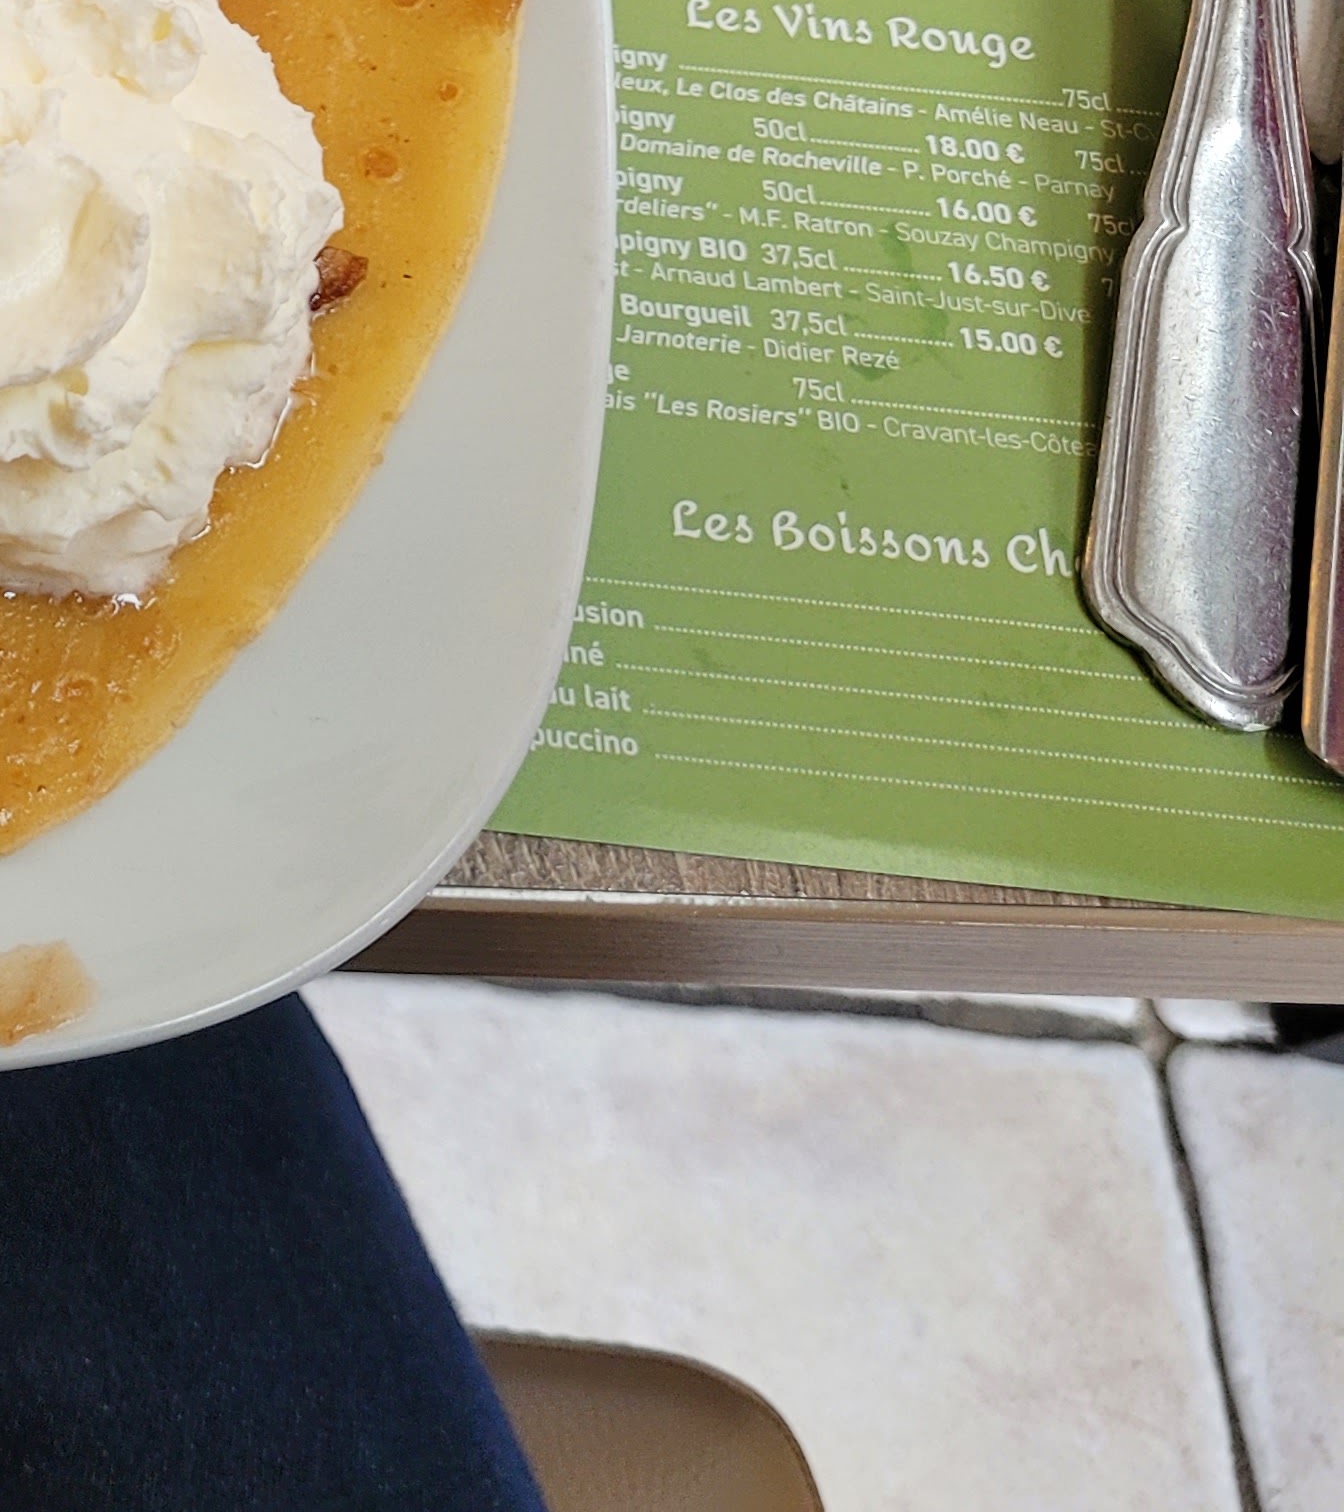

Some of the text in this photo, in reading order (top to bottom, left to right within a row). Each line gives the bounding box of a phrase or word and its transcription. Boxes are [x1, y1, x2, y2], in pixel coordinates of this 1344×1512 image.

[772, 2, 873, 45] Vins
[885, 16, 1036, 69] Rouge
[709, 80, 1079, 136] Clos des Châtains Amélie Neau
[1062, 88, 1112, 112] 75cl
[619, 132, 1114, 203] Domaine de Rocheville Porché Parnay
[752, 116, 1125, 174] 50cl 18.00 75cl
[762, 178, 1013, 226] 50cl 16.00
[699, 236, 1025, 290] BIO 37,5cl 16.50
[739, 206, 1113, 264] M.F. Ratron Souzay Champigny
[650, 261, 737, 288] Arnaud
[743, 270, 844, 299] Lambert
[866, 282, 1093, 324] Saint-Just-sur-Dive
[615, 324, 902, 371] Jarnoterie Didier Rezé
[619, 292, 1039, 357] Bourgueil 37,5cl 15.00
[792, 377, 846, 403] 75cl
[816, 409, 861, 434] BIO
[672, 499, 991, 569] Les Boissons
[583, 682, 633, 713] lait
